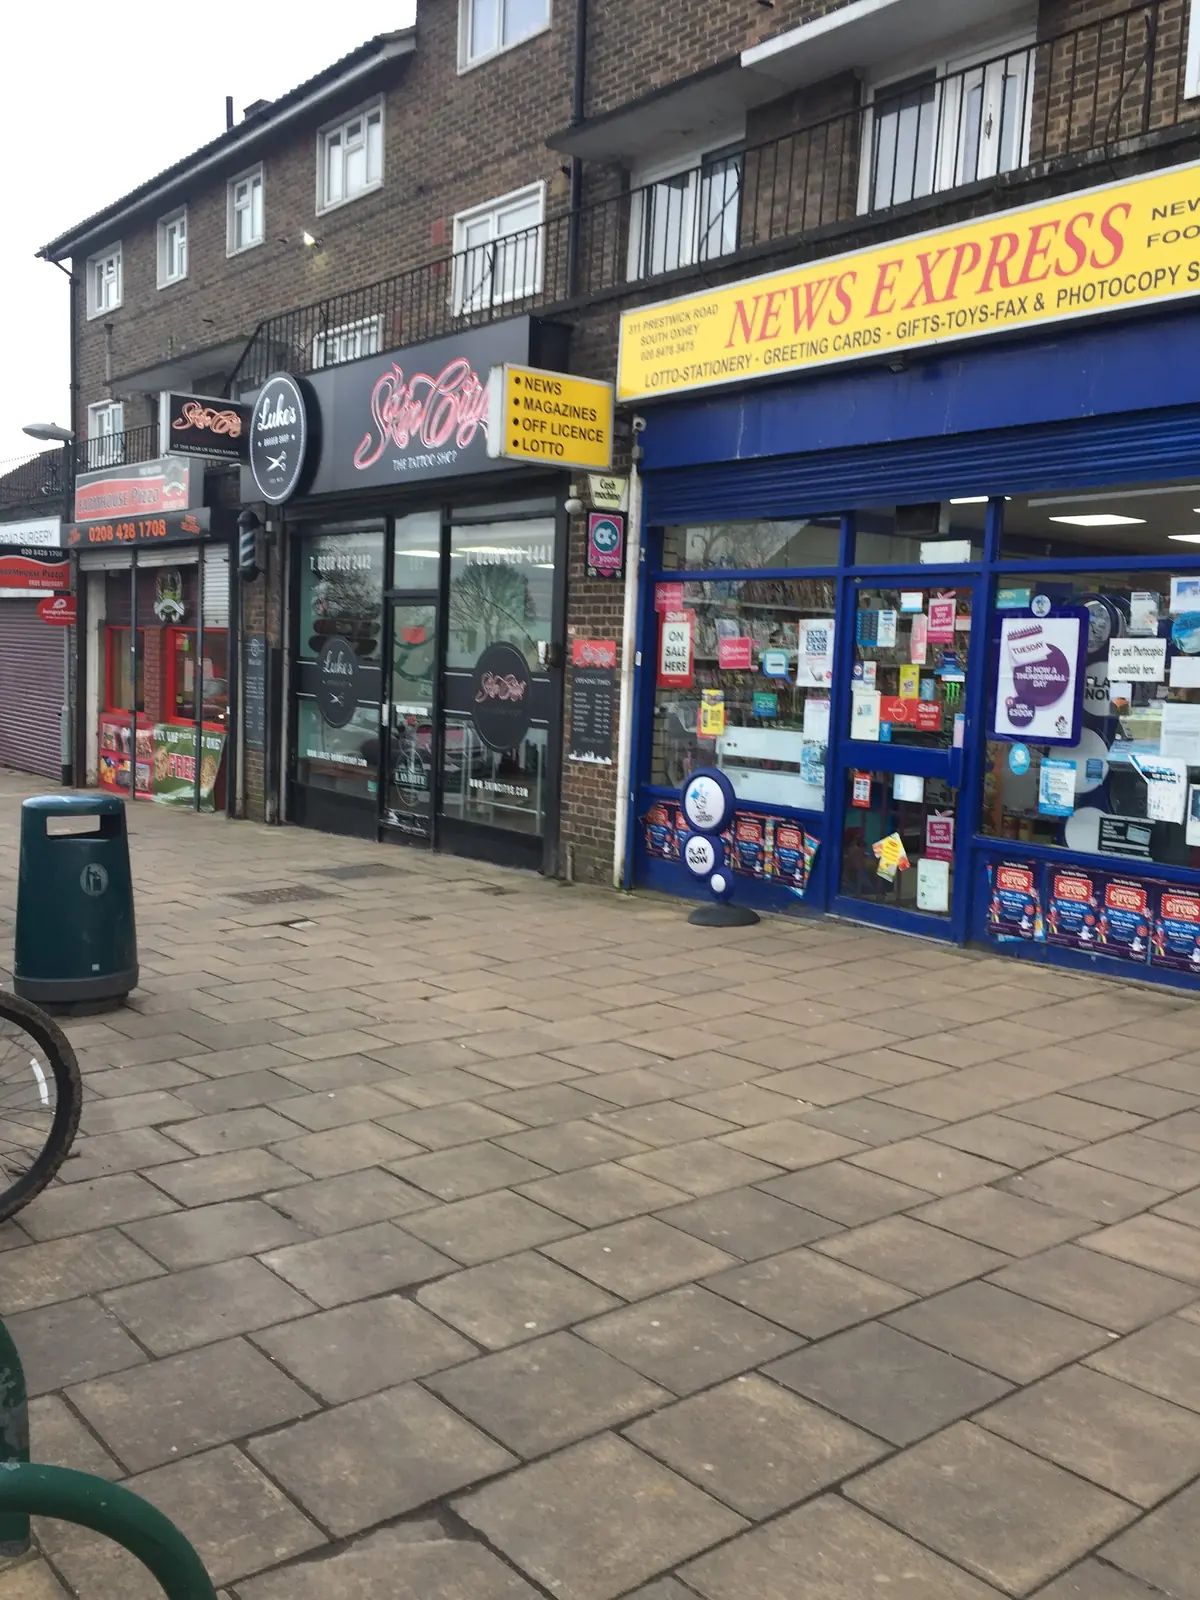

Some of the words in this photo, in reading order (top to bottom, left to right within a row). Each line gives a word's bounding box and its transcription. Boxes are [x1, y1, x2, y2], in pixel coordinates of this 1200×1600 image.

[724, 271, 858, 348] NEWS
[865, 202, 1132, 318] EXPRESS
[628, 323, 641, 335] 311
[643, 310, 691, 332] PRESTWICK
[693, 304, 718, 318] ROAD
[645, 353, 752, 389] LOTTO-STATIONERY
[763, 338, 828, 365] GREETING
[832, 327, 881, 351] CARDS
[896, 292, 1028, 340] GIFTS-TOYS-FAX
[1033, 292, 1045, 312] &
[1057, 264, 1181, 308] PHOTOCOPY
[640, 331, 668, 346] SOUTH
[670, 325, 699, 340] OXHEY
[524, 376, 562, 395] NEWS
[257, 393, 296, 431] Luke's
[524, 397, 597, 422] MAGAZINES
[522, 417, 547, 434] OFF
[551, 422, 604, 443] LICENCE
[522, 438, 564, 456] LOTTO
[392, 458, 407, 471] THE
[408, 453, 435, 468] TATTOO
[437, 450, 458, 465] SHOP
[600, 478, 616, 489] Cash
[79, 491, 128, 512] FARMHOUSE
[594, 490, 621, 500] machine
[20, 529, 53, 546] SURGERY
[89, 525, 113, 542] 0208
[116, 523, 136, 539] 428
[138, 519, 167, 537] 1708
[668, 631, 684, 642] ON
[665, 647, 686, 657] SALE
[1012, 641, 1044, 655] TUESDAY
[1111, 645, 1121, 657] Fax
[1123, 646, 1132, 656] and
[1134, 645, 1164, 659] Photocopies
[322, 650, 353, 675] Luke's
[664, 661, 687, 672] HERE
[1025, 665, 1032, 673] IS
[1033, 666, 1051, 674] NOW
[1118, 664, 1141, 674] available
[1016, 672, 1066, 681] THUNDERBALL
[917, 703, 939, 712] Sun
[166, 731, 178, 743] ONE
[689, 847, 706, 855] PLAY
[689, 856, 708, 864] NOW
